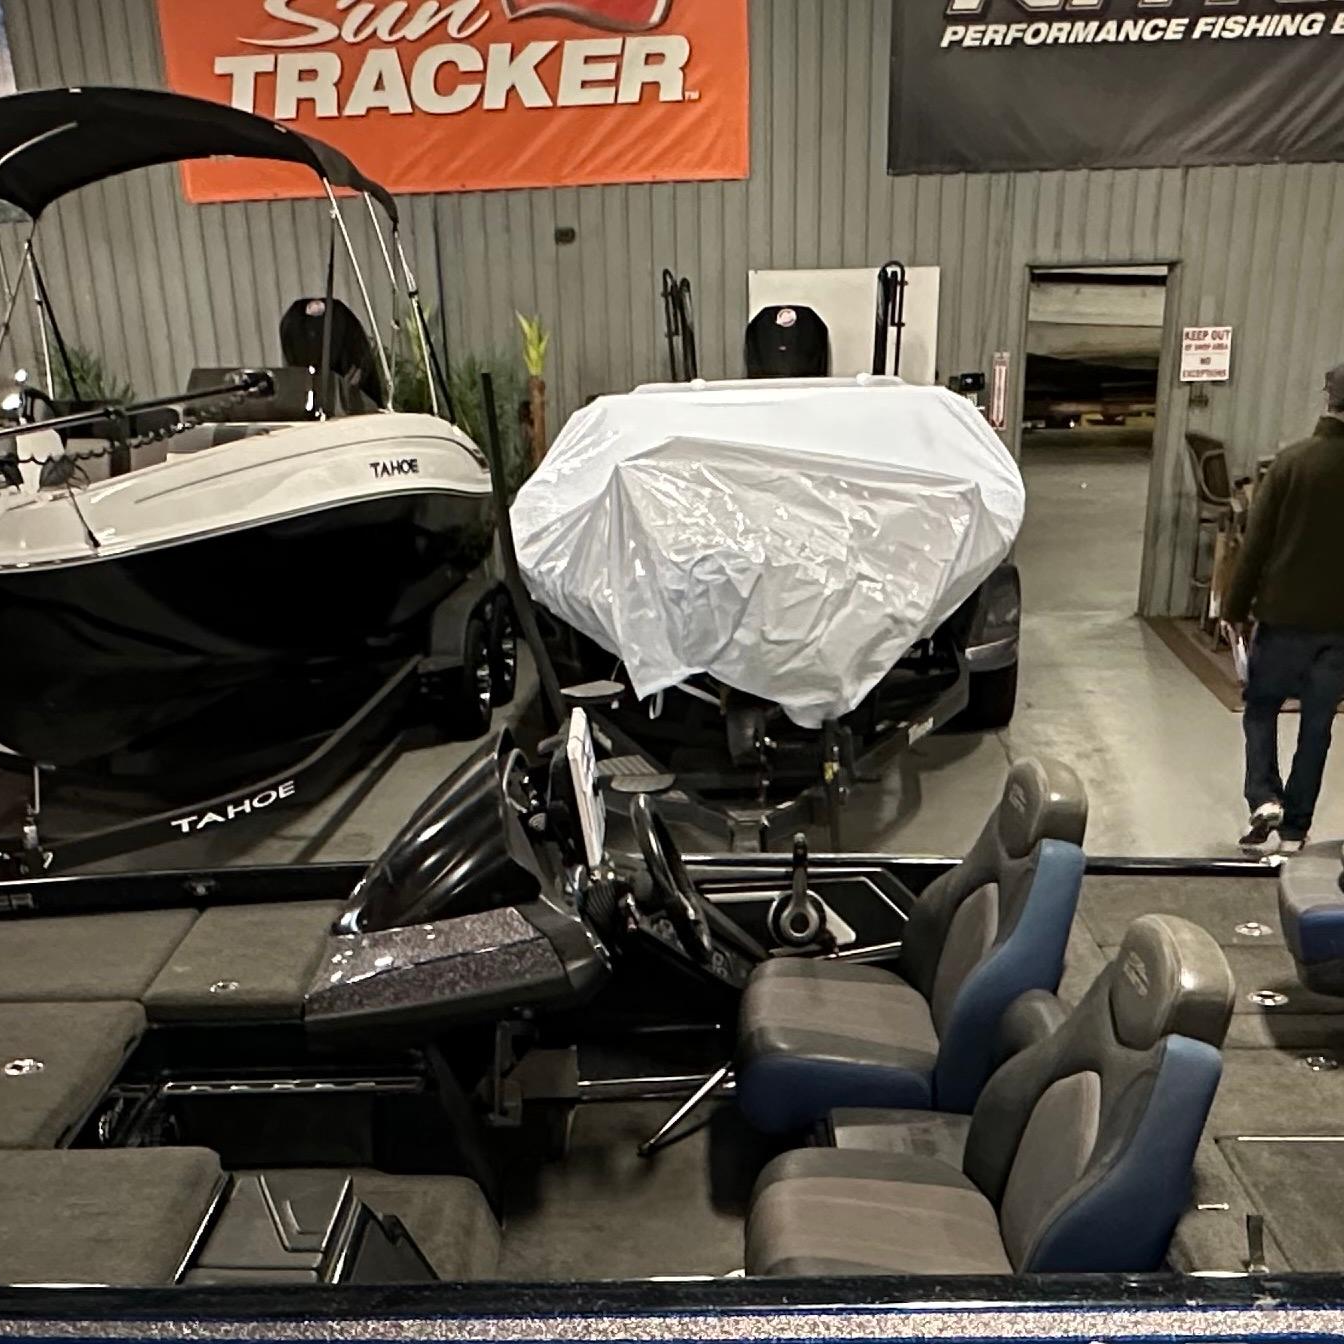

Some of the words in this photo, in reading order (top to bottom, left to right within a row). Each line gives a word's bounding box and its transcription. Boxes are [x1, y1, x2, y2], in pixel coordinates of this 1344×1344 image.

[237, 0, 491, 46] Sun
[940, 18, 1190, 48] PERFORMANCE
[1192, 13, 1326, 40] FISHING
[214, 34, 692, 119] TRACKER
[1184, 330, 1209, 341] KEEP
[1211, 329, 1231, 341] OUT
[369, 458, 419, 479] TAHOE
[171, 780, 296, 834] TAHOE
